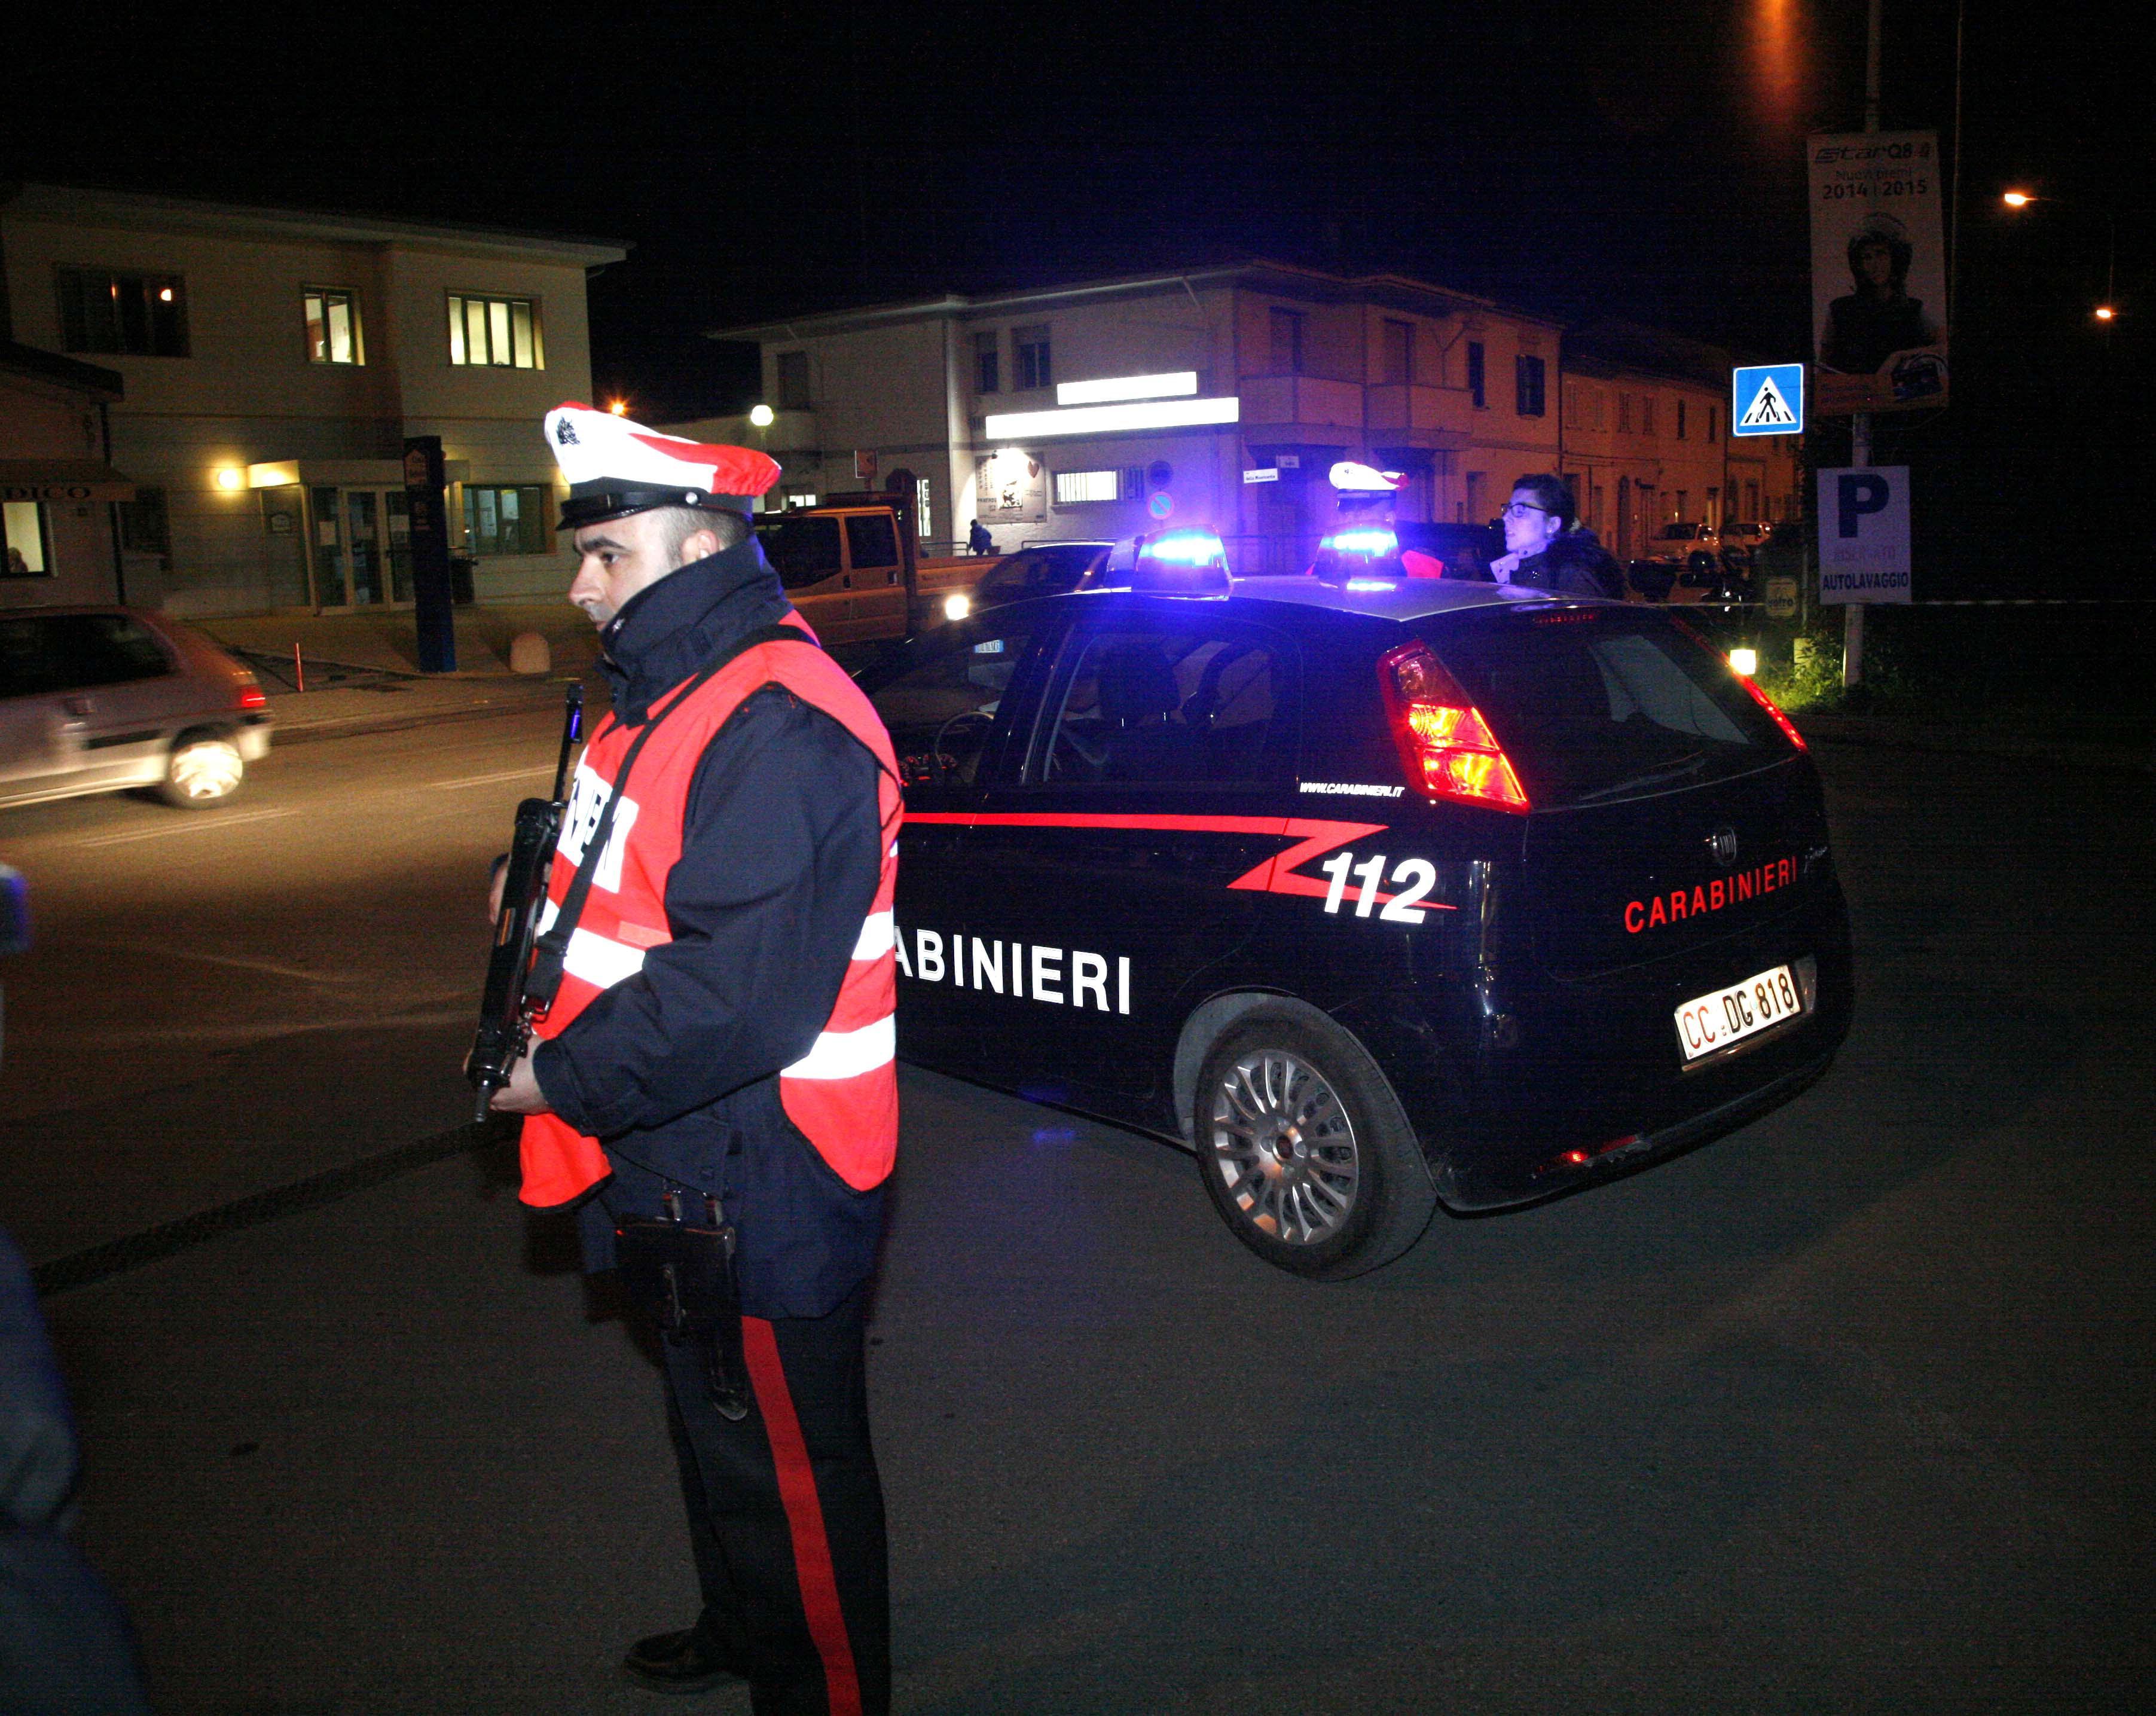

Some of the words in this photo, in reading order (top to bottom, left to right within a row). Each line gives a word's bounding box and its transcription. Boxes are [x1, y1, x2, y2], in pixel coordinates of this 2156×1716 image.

[1823, 182, 1867, 199] 2014
[1882, 179, 1927, 196] 2015
[1838, 474, 1889, 538] P
[1823, 572, 1908, 590] AUTOLAVAGGIO
[1300, 782, 1405, 797] WWW.CARABINIERI.IT
[1323, 852, 1436, 923] 112
[1624, 856, 1797, 933] CARABINIERI
[1683, 1006, 1715, 1049] CC
[1755, 973, 1794, 1020] 818
